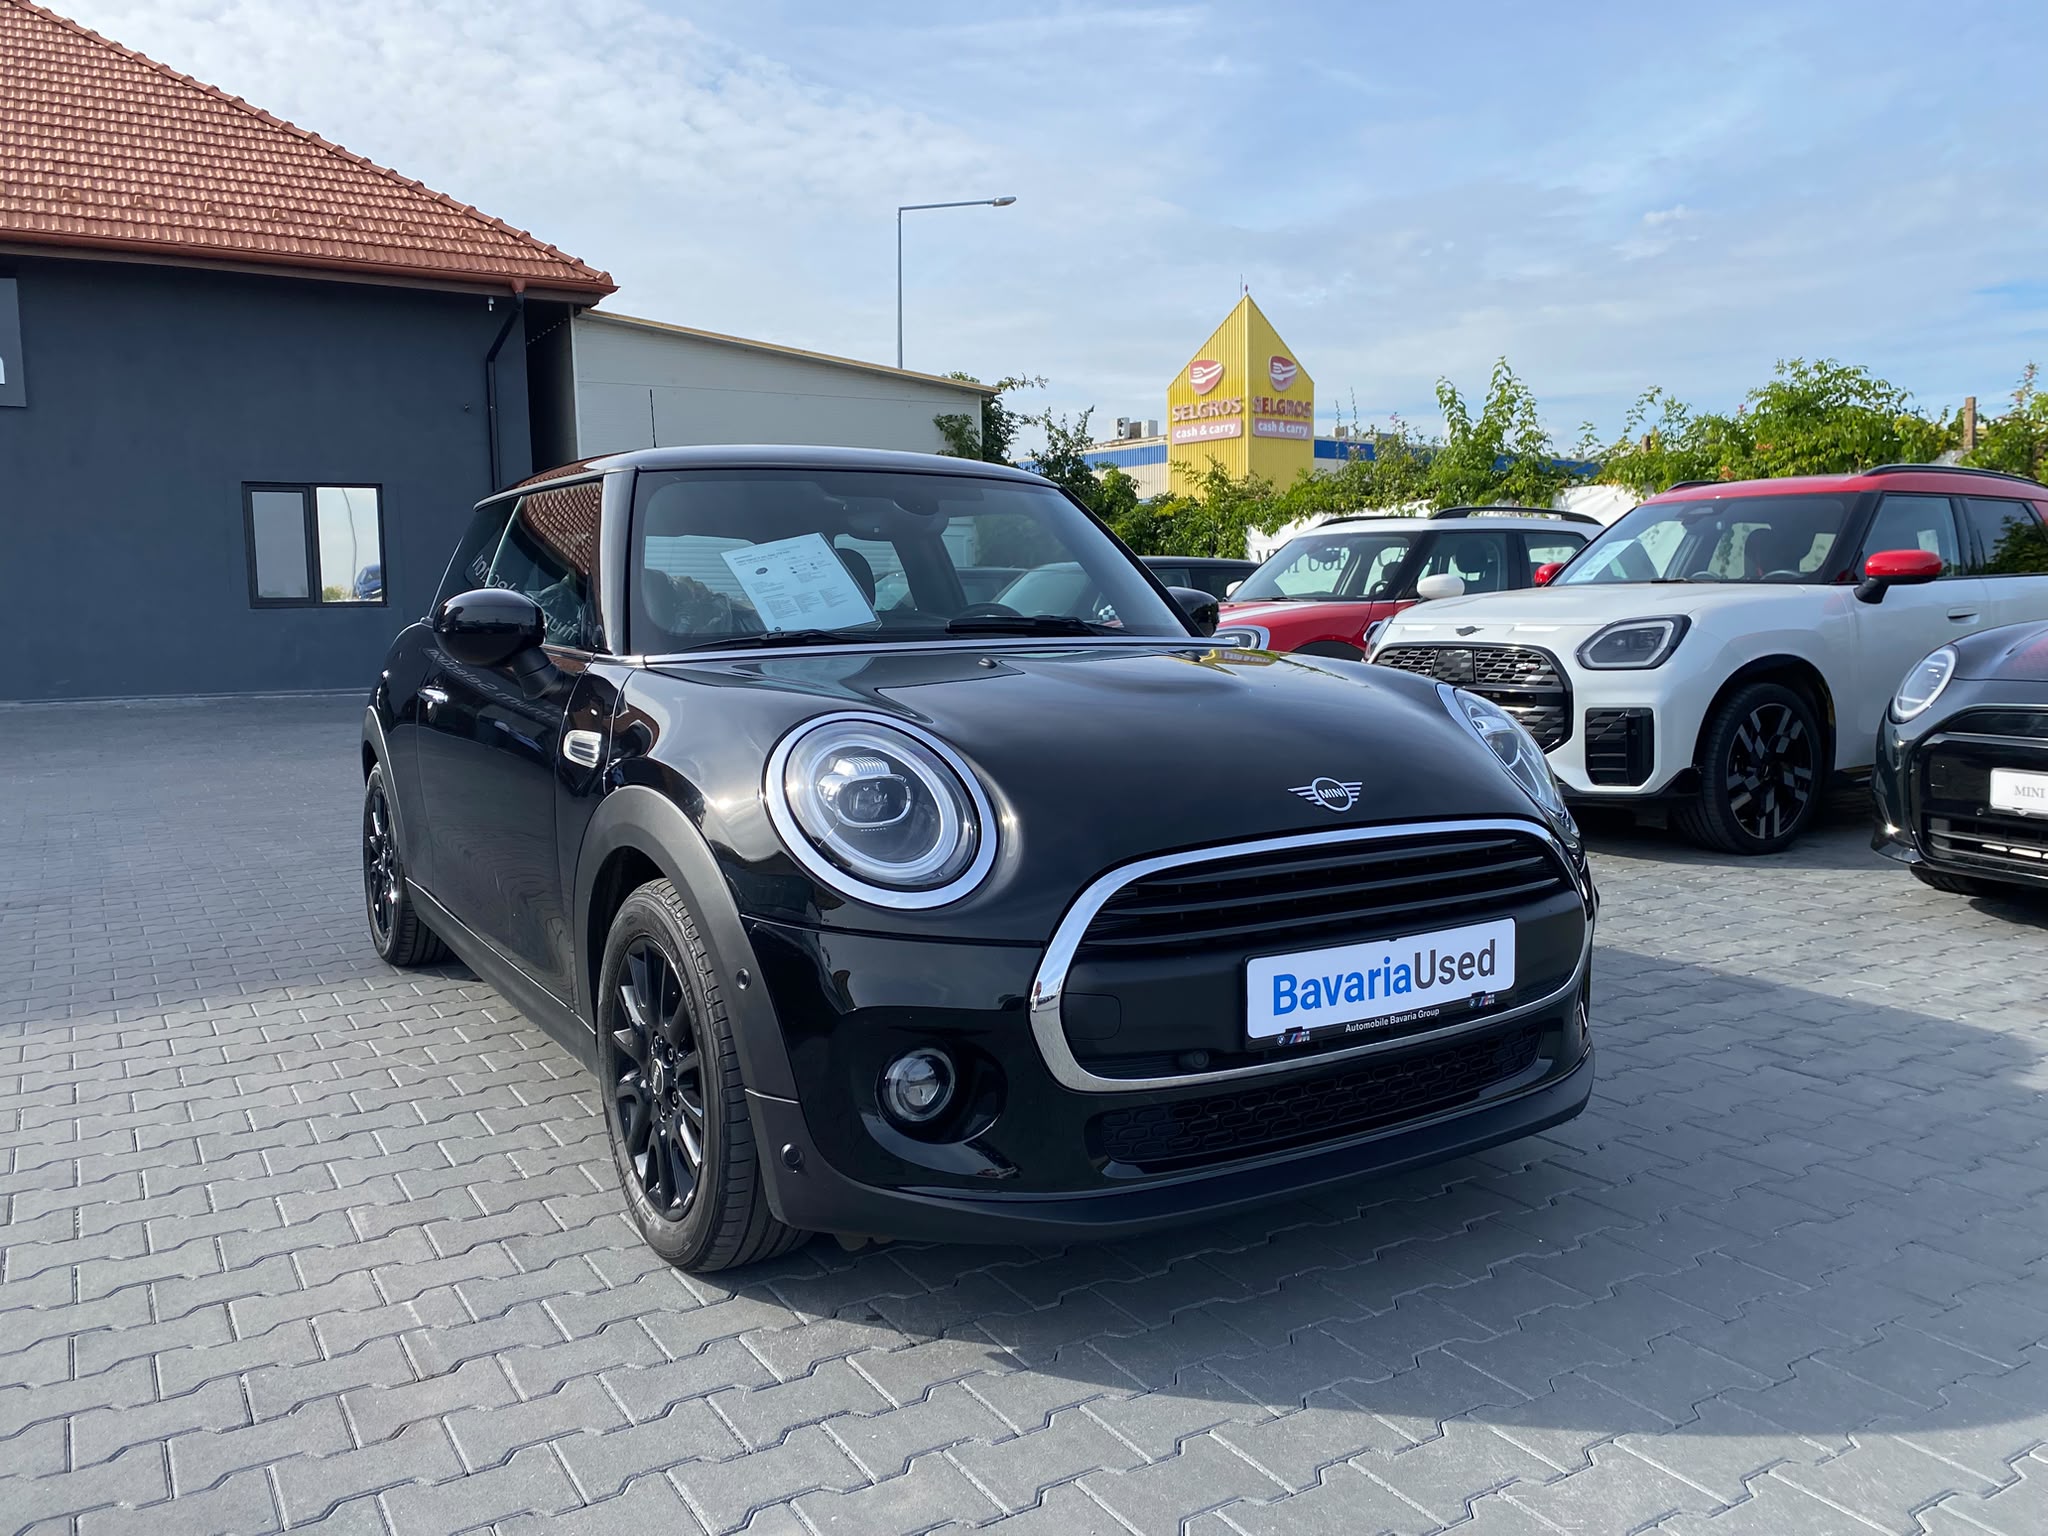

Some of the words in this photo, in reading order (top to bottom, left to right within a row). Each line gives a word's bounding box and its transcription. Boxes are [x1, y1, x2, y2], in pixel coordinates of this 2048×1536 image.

[1172, 397, 1242, 422] SELGROS
[1252, 396, 1311, 417] SELGROS
[1176, 426, 1197, 439] cash
[1199, 425, 1208, 435] &
[1209, 423, 1236, 435] carry
[1258, 421, 1277, 432] cash
[1278, 422, 1286, 433] &
[1286, 425, 1308, 437] carry
[1318, 787, 1347, 799] MINI
[2014, 785, 2046, 799] MINI
[1273, 938, 1496, 1016] BavariaUsed
[1345, 1018, 1389, 1033] Automobile
[1390, 1011, 1417, 1025] Bavaria
[1417, 1008, 1440, 1019] Group
